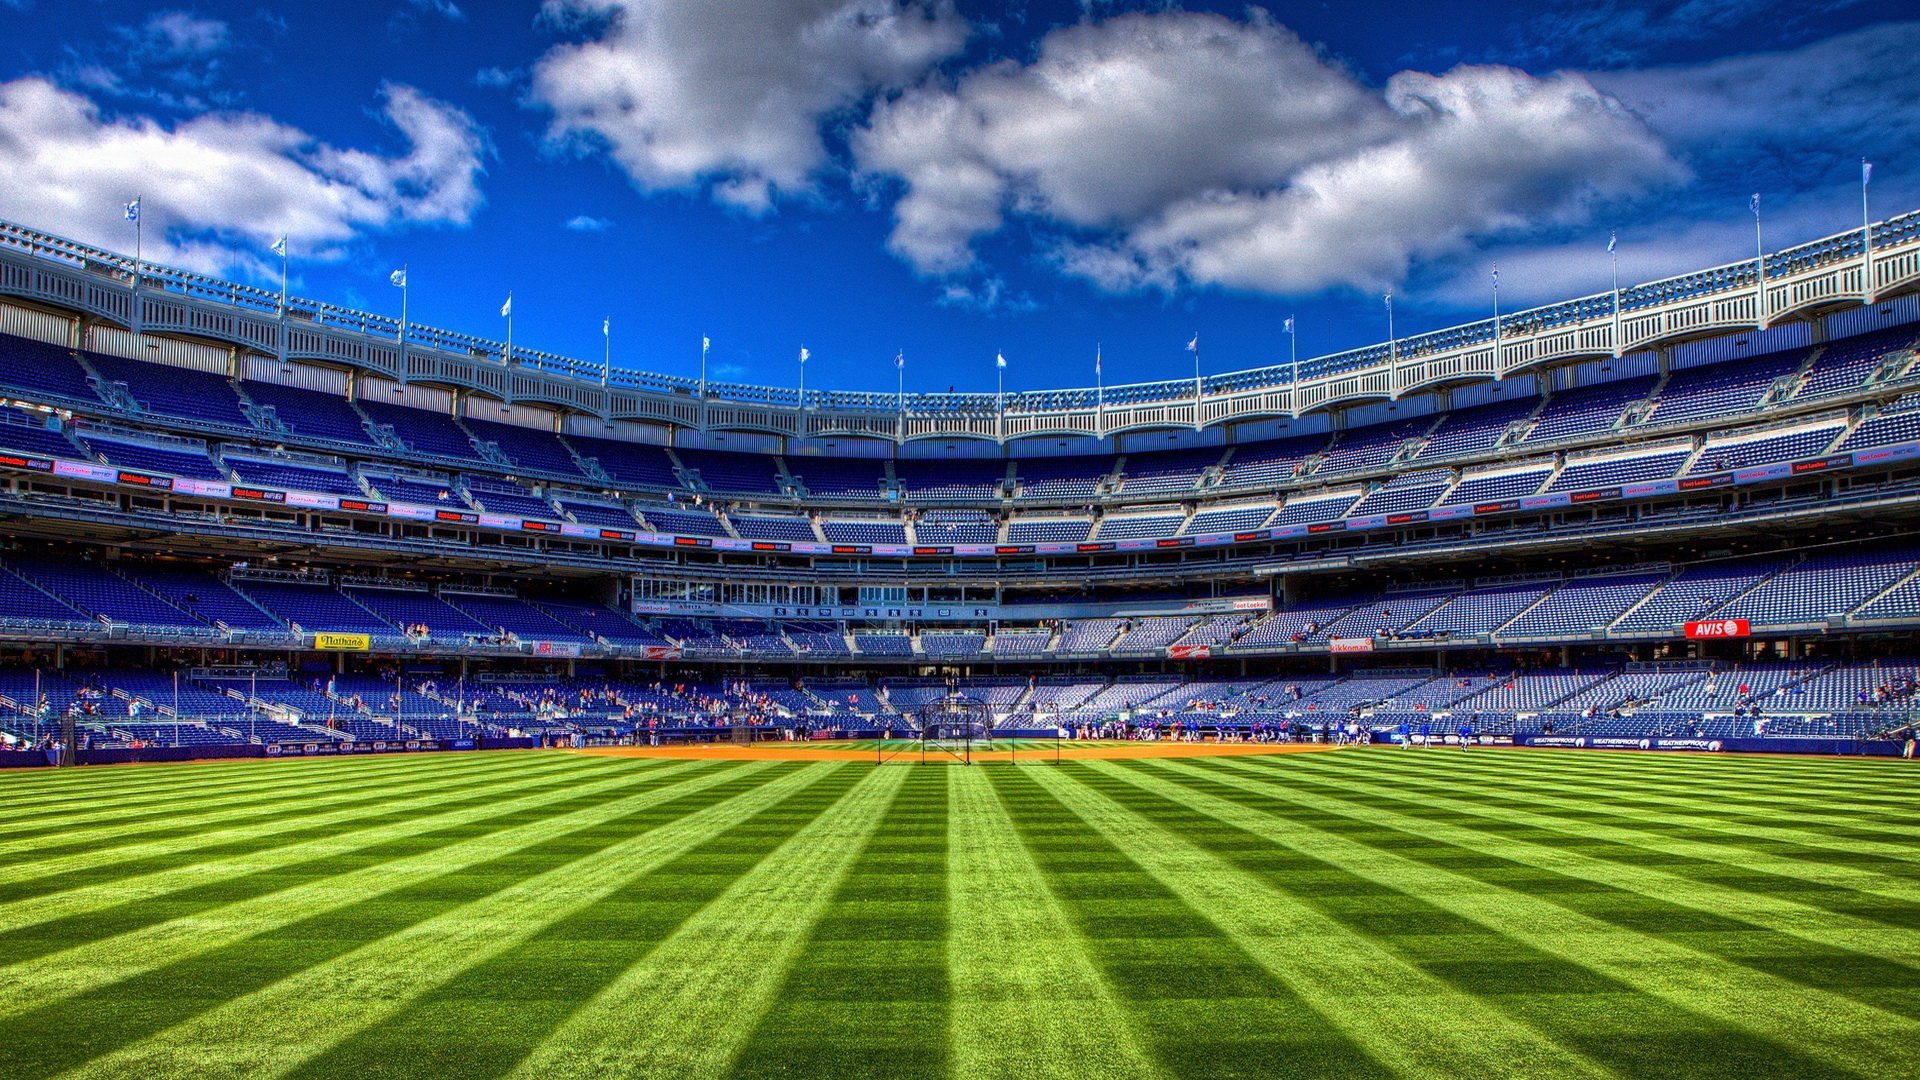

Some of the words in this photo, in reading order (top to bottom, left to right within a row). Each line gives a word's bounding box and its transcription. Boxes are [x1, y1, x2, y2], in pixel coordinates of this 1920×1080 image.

[1247, 600, 1266, 608] Locker
[1695, 622, 1723, 636] AVIS
[321, 635, 364, 648] Nathan's
[1593, 738, 1640, 746] WEATHERPROOF
[1657, 739, 1708, 747] WEATHERPROOF
